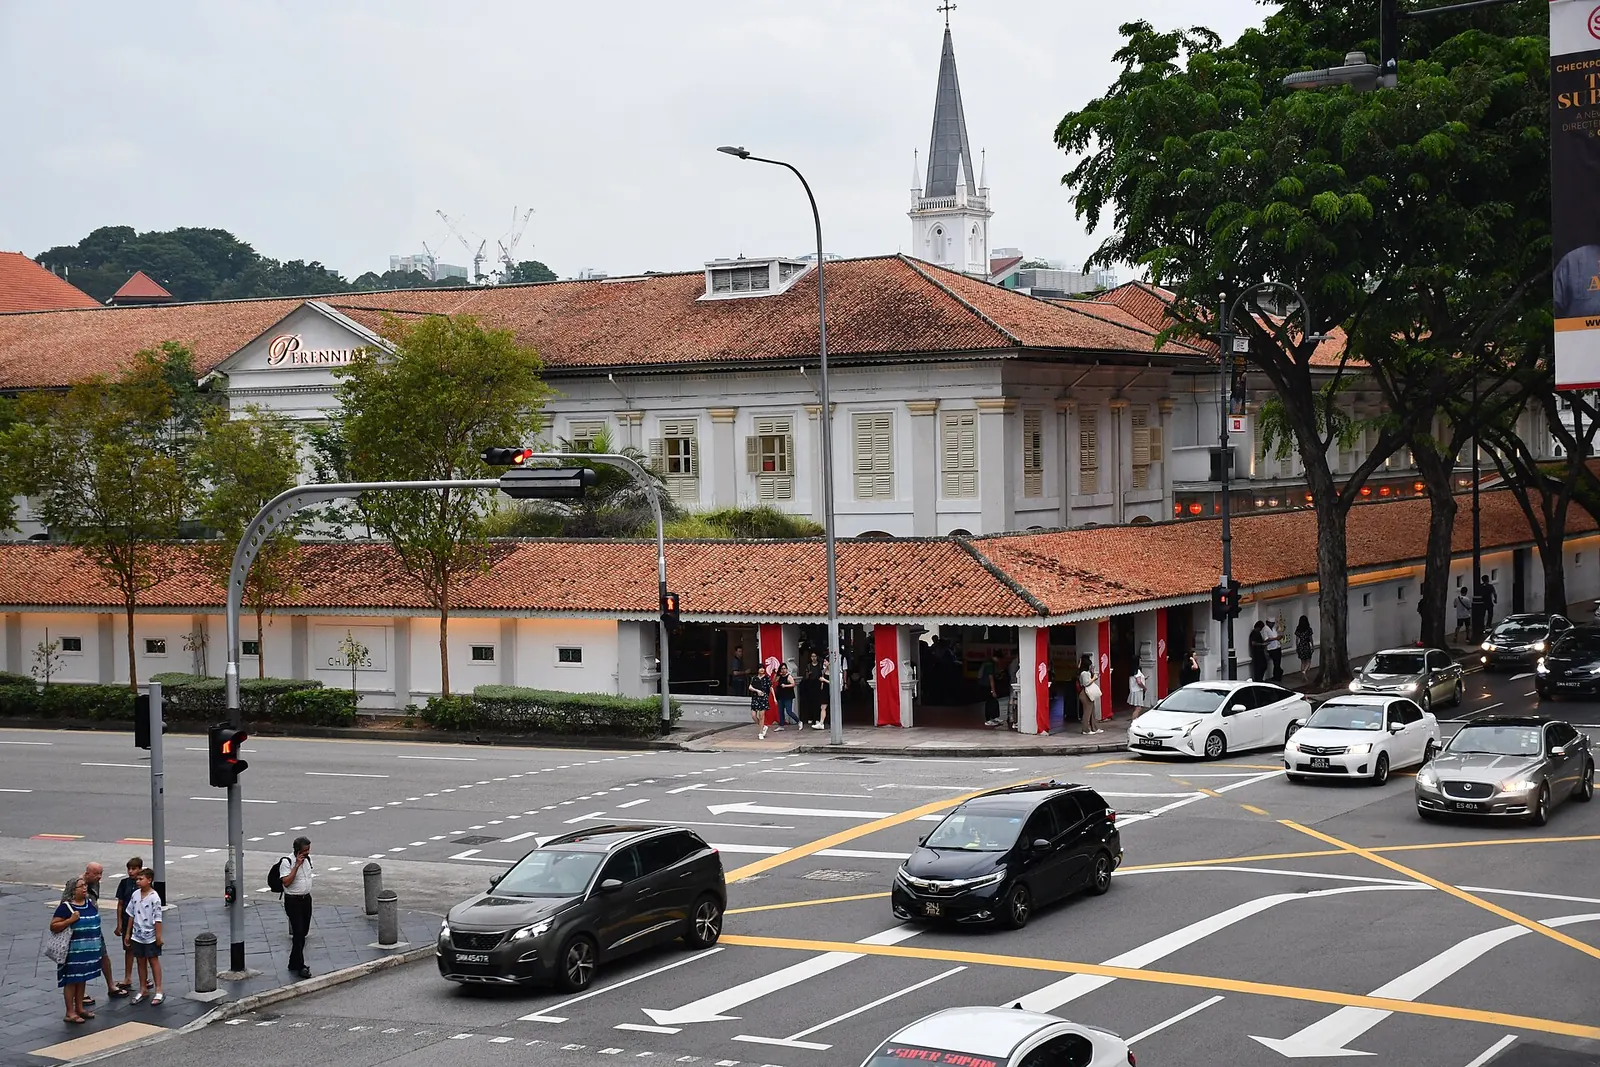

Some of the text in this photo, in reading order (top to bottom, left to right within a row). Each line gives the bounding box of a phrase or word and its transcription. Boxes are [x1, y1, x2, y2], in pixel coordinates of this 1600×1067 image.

[1562, 119, 1600, 132] DIRECTE
[267, 334, 367, 366] PERENNIA
[896, 1048, 942, 1061] SUPER
